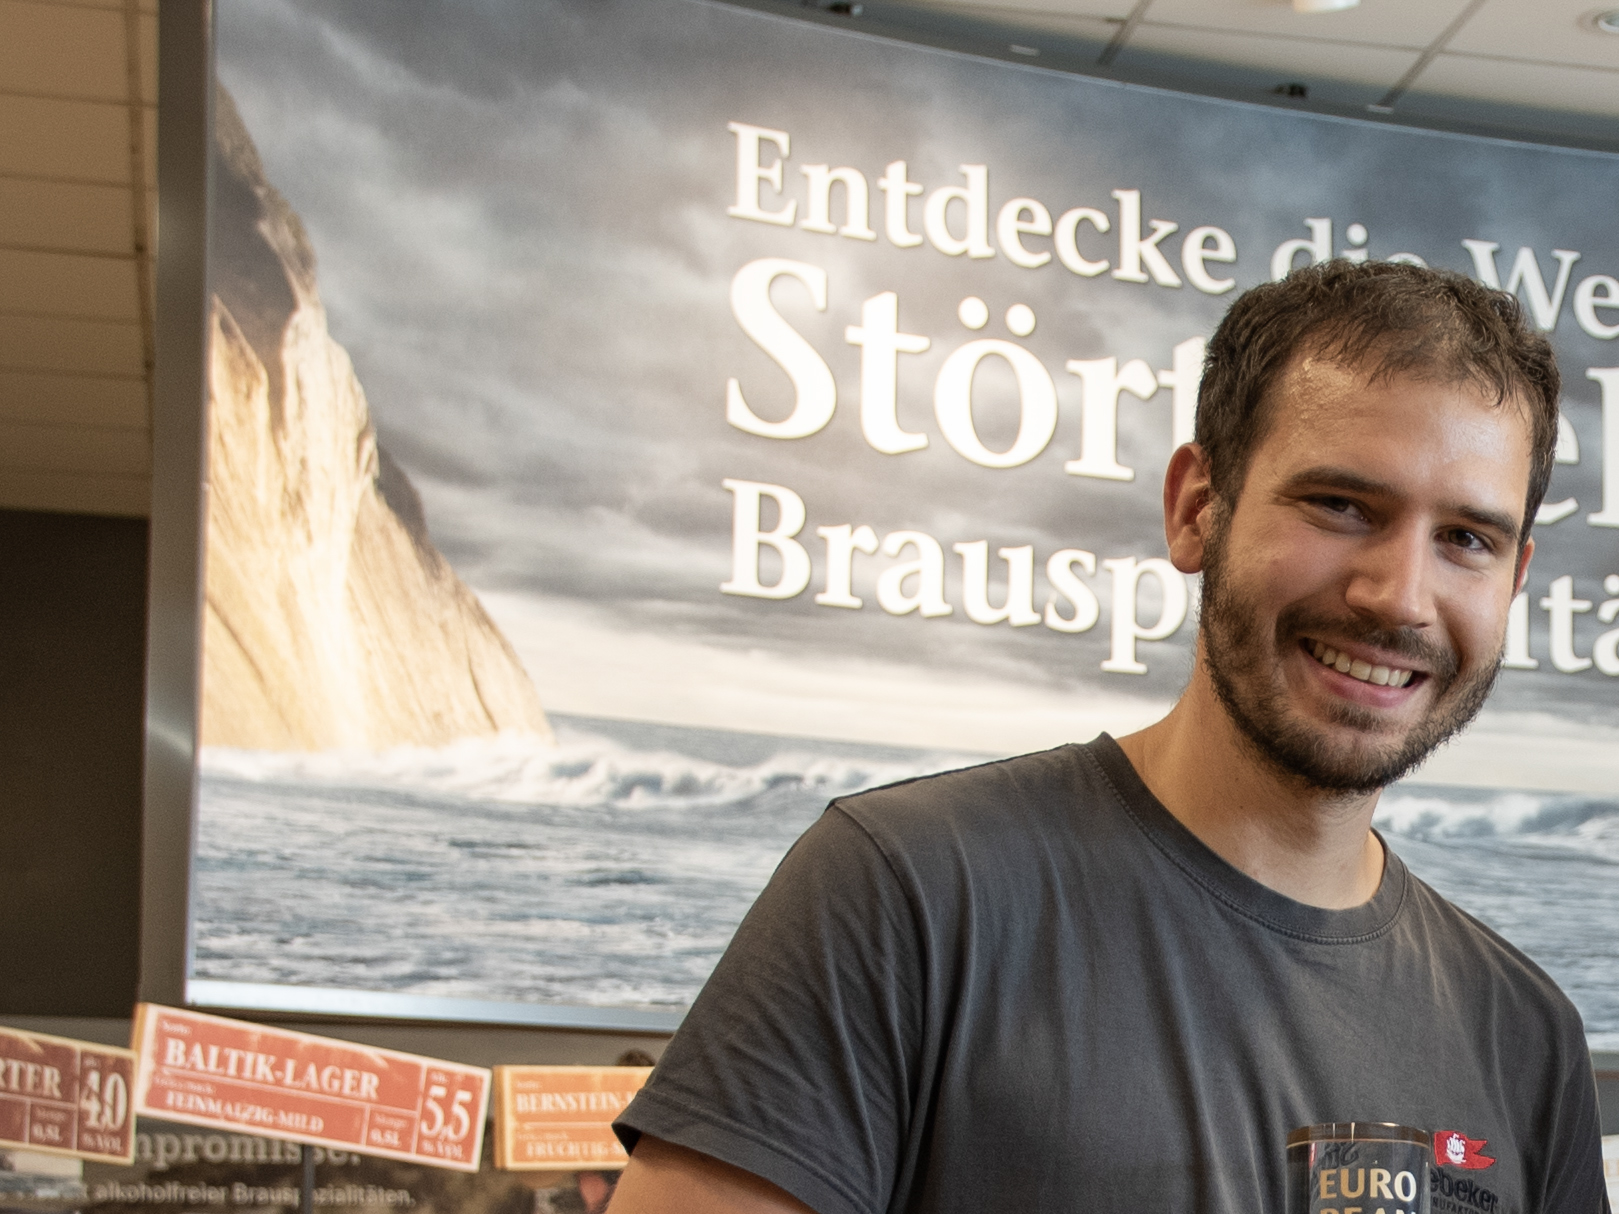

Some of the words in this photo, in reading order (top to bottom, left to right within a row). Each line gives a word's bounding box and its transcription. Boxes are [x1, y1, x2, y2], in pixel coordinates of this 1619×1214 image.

[727, 121, 1238, 295] Entdecke
[164, 1037, 380, 1102] BALTIK-LAGER
[166, 1091, 325, 1134] FEINMALZIG-MILD
[1319, 1168, 1417, 1202] EURO
